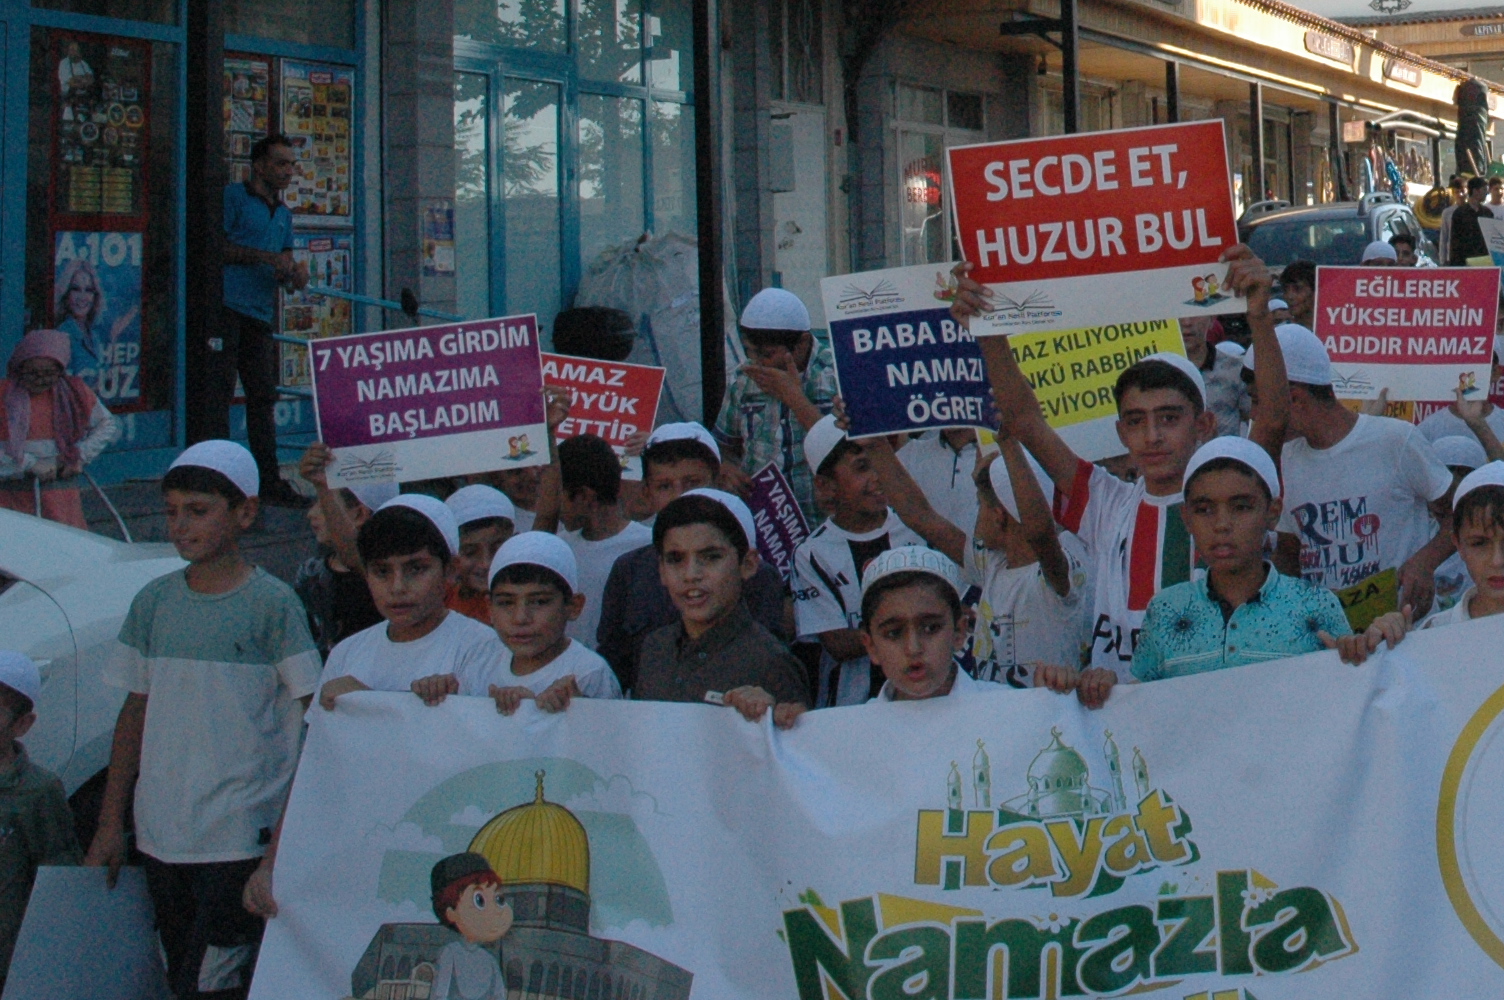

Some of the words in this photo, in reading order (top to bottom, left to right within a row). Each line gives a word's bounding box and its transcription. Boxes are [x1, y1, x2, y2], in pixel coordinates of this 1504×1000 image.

[1473, 23, 1502, 36] AKPINAR
[983, 151, 1119, 202] SECDE
[1128, 144, 1188, 189] ET,
[976, 217, 1127, 268] HUZUR
[1135, 208, 1222, 254] BUL
[1355, 275, 1460, 298] EĞİLEREK
[1326, 303, 1483, 326] YÜKSELMENİN
[316, 350, 332, 371] 7
[336, 337, 434, 371] YAŞIMA
[439, 323, 530, 356] GİRDİM
[852, 321, 936, 354] BABA
[940, 319, 976, 344] BA
[1053, 319, 1169, 355] KILIYORUM
[1324, 336, 1402, 355] ADIDIR
[1407, 337, 1487, 355] NAMAZ
[99, 342, 140, 366] HEP
[357, 364, 500, 402] NAMAZIMA
[542, 360, 627, 387] AMAZ
[886, 358, 984, 387] NAMAZI
[1023, 364, 1066, 391] NKÜ
[565, 386, 640, 415] ÜYÜK
[907, 391, 983, 423] ÖĞRET
[1038, 385, 1118, 419] EVİYOR
[368, 399, 500, 438] BAŞLADIM
[759, 470, 776, 483] 7
[768, 482, 806, 546] YAŞIMA
[914, 790, 1199, 898] Hayat
[783, 866, 1357, 1000] Namazla
